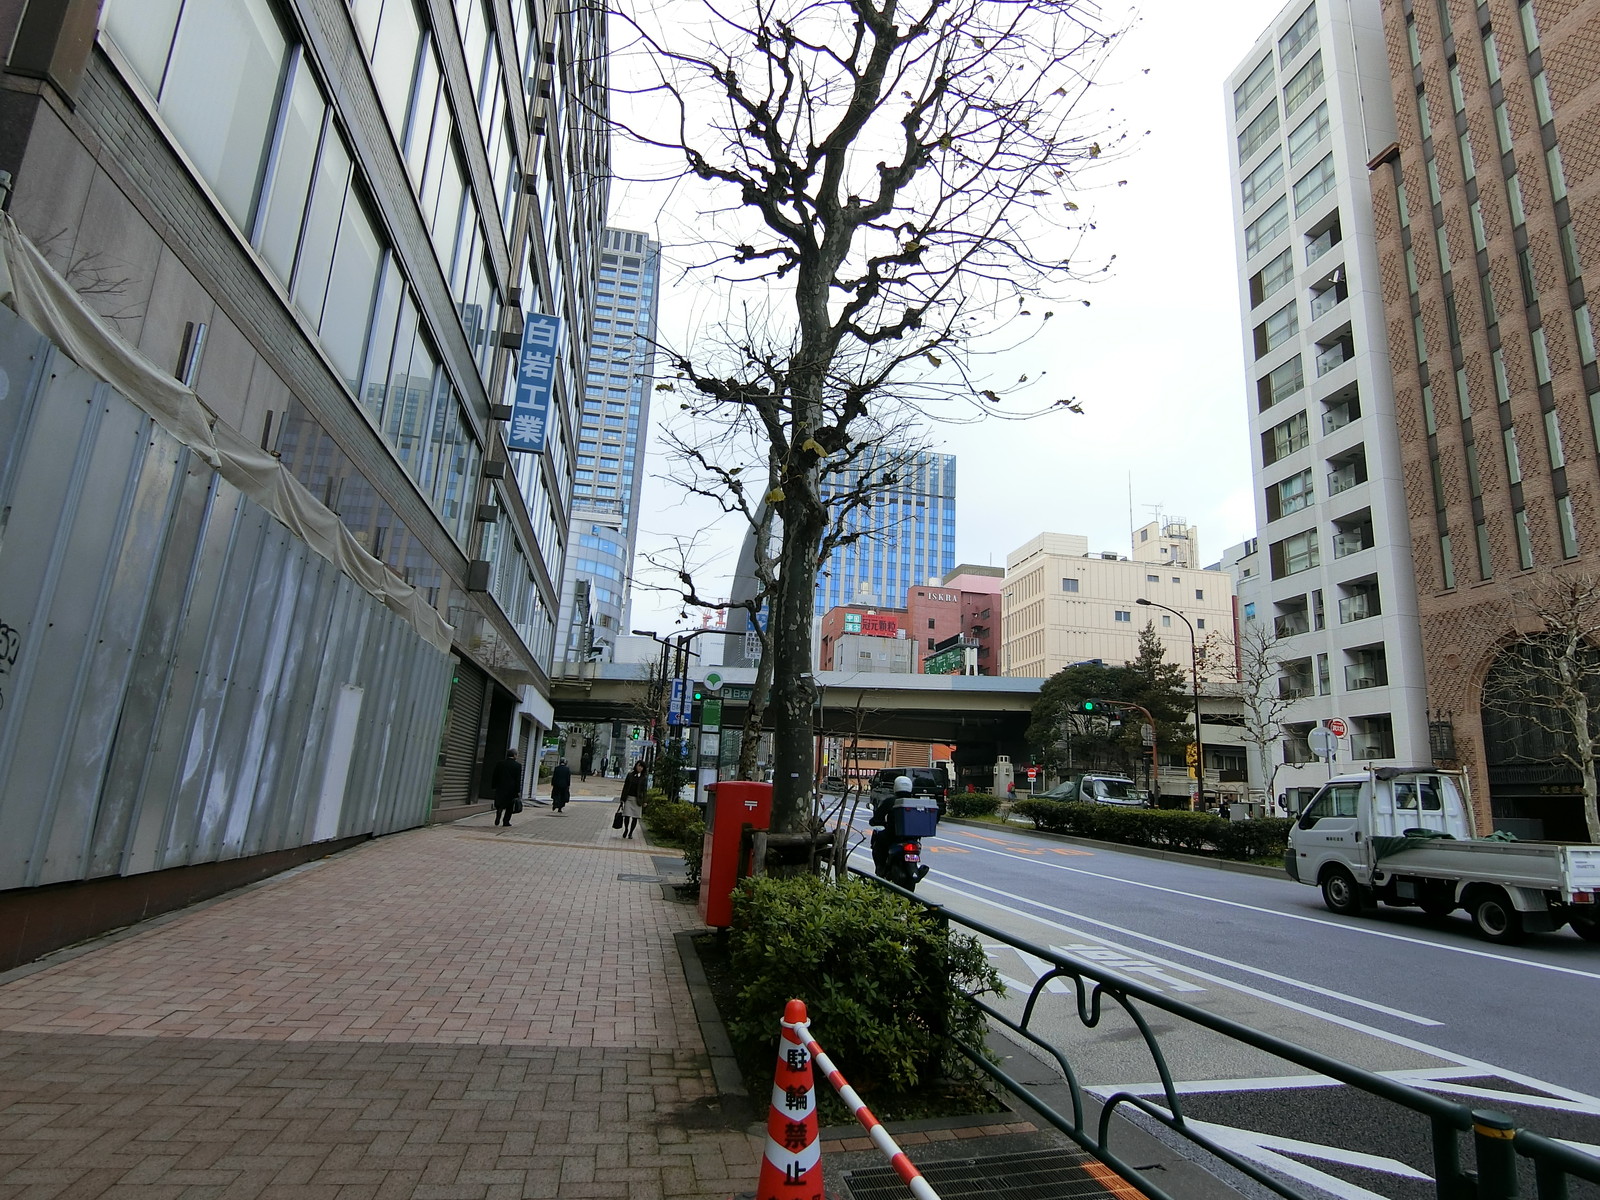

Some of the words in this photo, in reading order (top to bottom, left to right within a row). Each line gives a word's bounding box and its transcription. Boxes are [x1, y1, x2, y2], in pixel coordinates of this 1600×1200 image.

[512, 318, 557, 445] 白岩工業
[927, 592, 958, 603] ISKRA
[784, 1049, 808, 1186] 駐輪禁止
